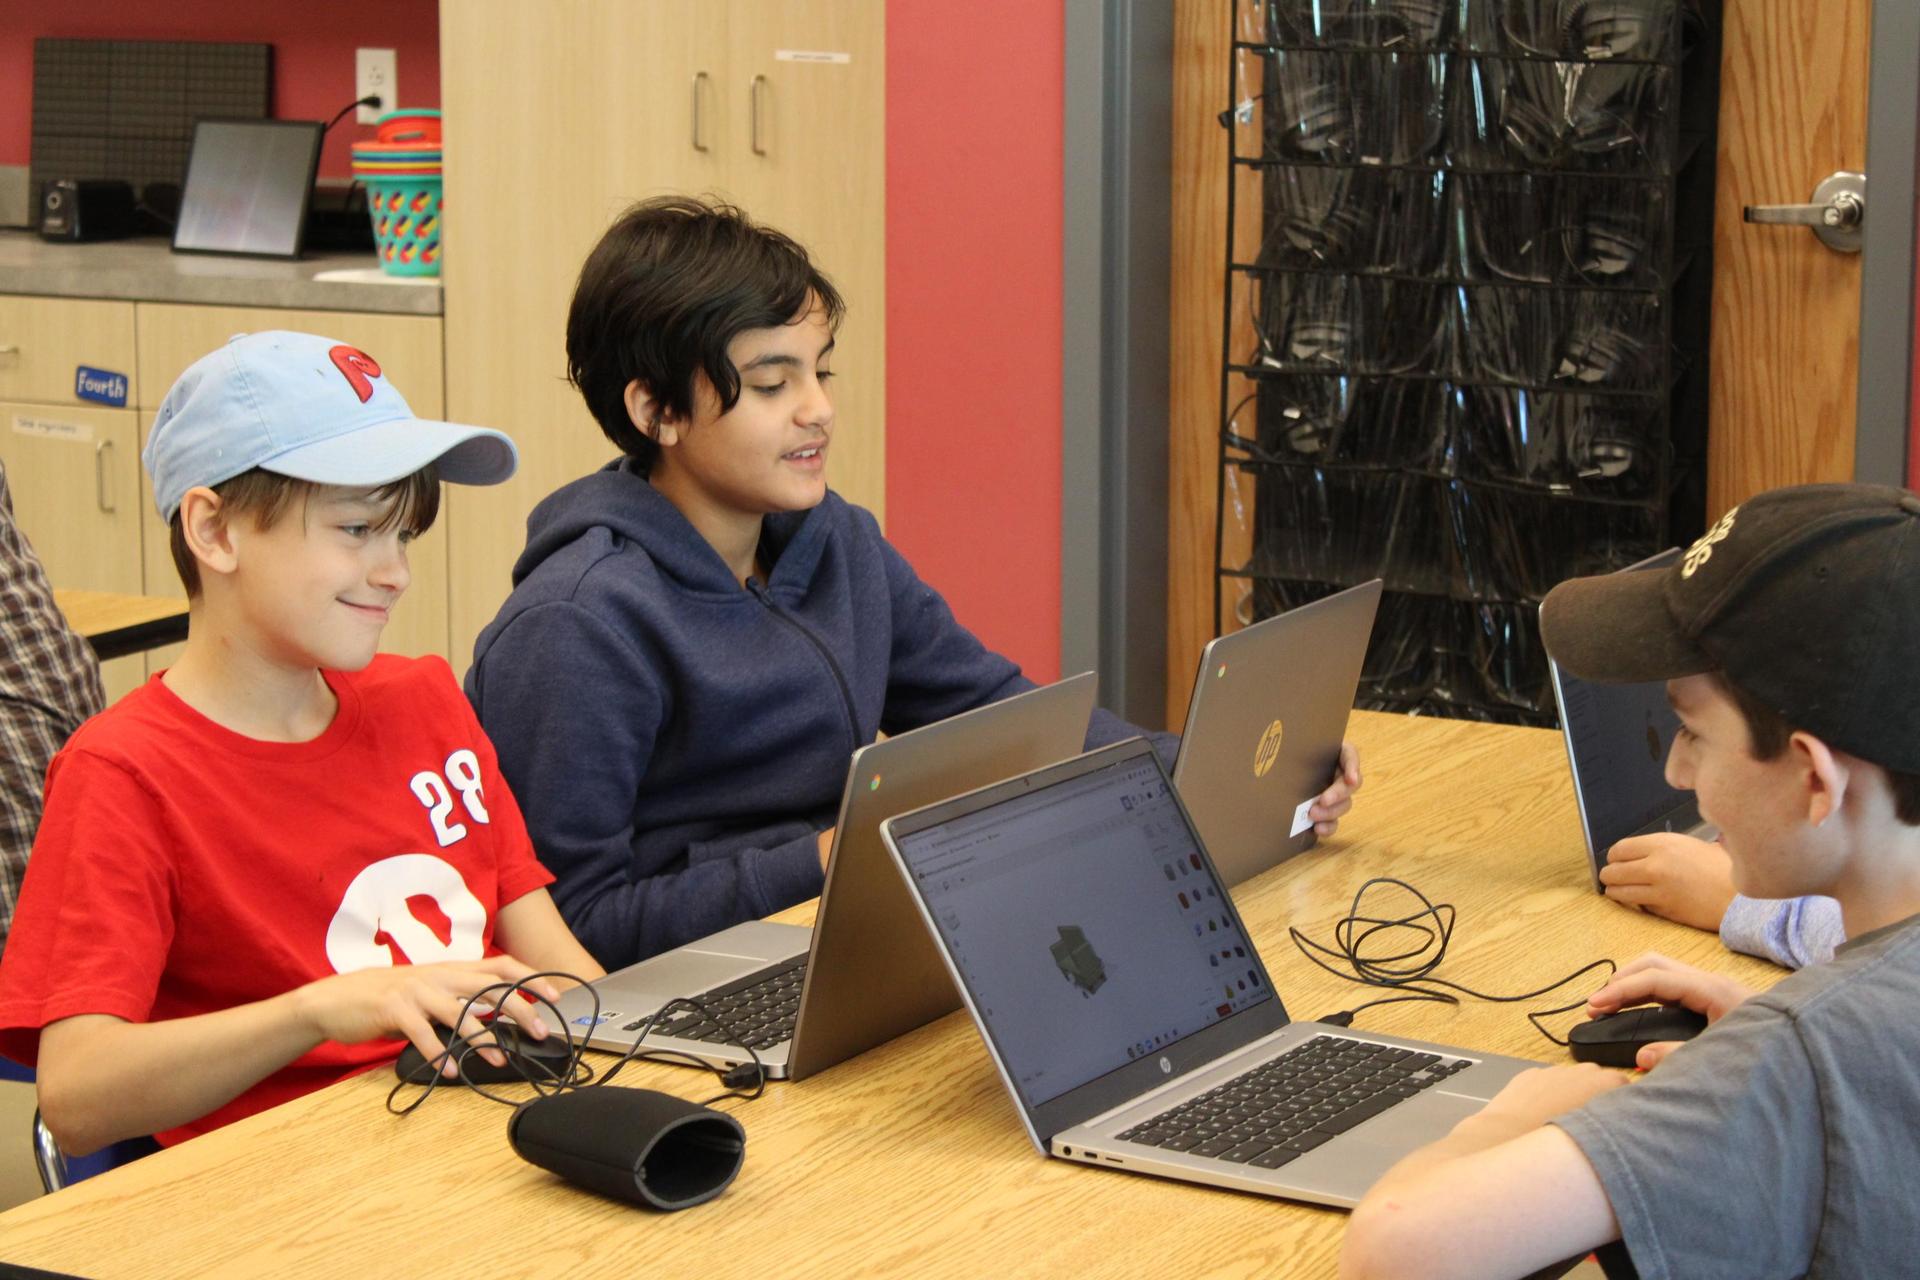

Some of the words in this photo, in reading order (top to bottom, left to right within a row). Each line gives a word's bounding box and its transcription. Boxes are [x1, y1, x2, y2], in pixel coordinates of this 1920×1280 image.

[78, 371, 125, 399] Fourth
[328, 345, 381, 404] P
[409, 748, 490, 848] 28
